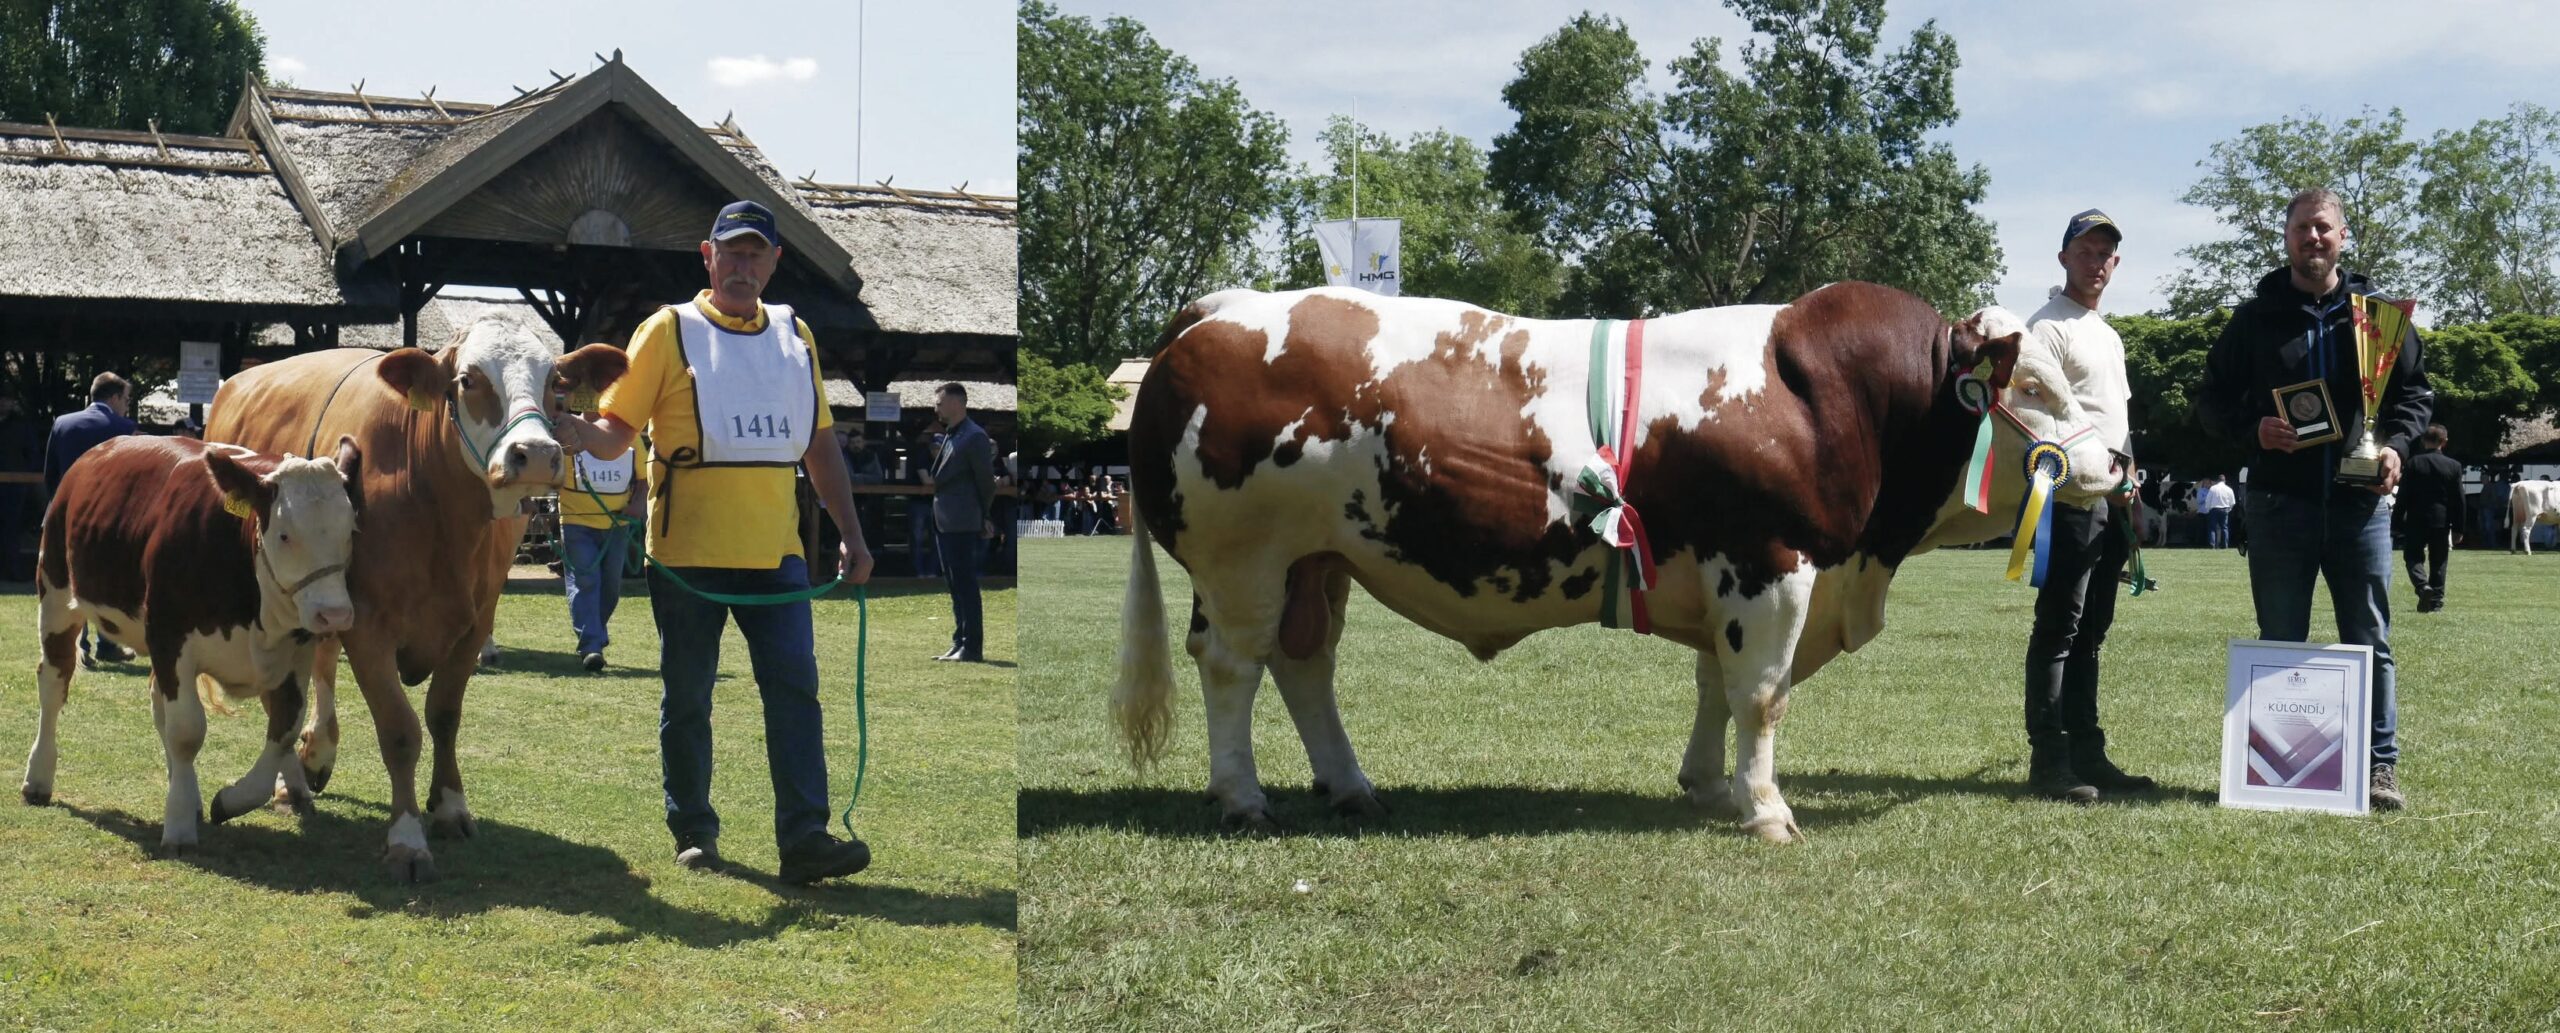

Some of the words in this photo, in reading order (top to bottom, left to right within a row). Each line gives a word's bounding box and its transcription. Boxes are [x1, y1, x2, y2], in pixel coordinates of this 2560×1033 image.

[1360, 271, 1395, 281] HMG
[731, 414, 791, 439] 1414
[592, 470, 621, 482] 1415
[2268, 701, 2325, 715] KÜLÖNDÍJ
